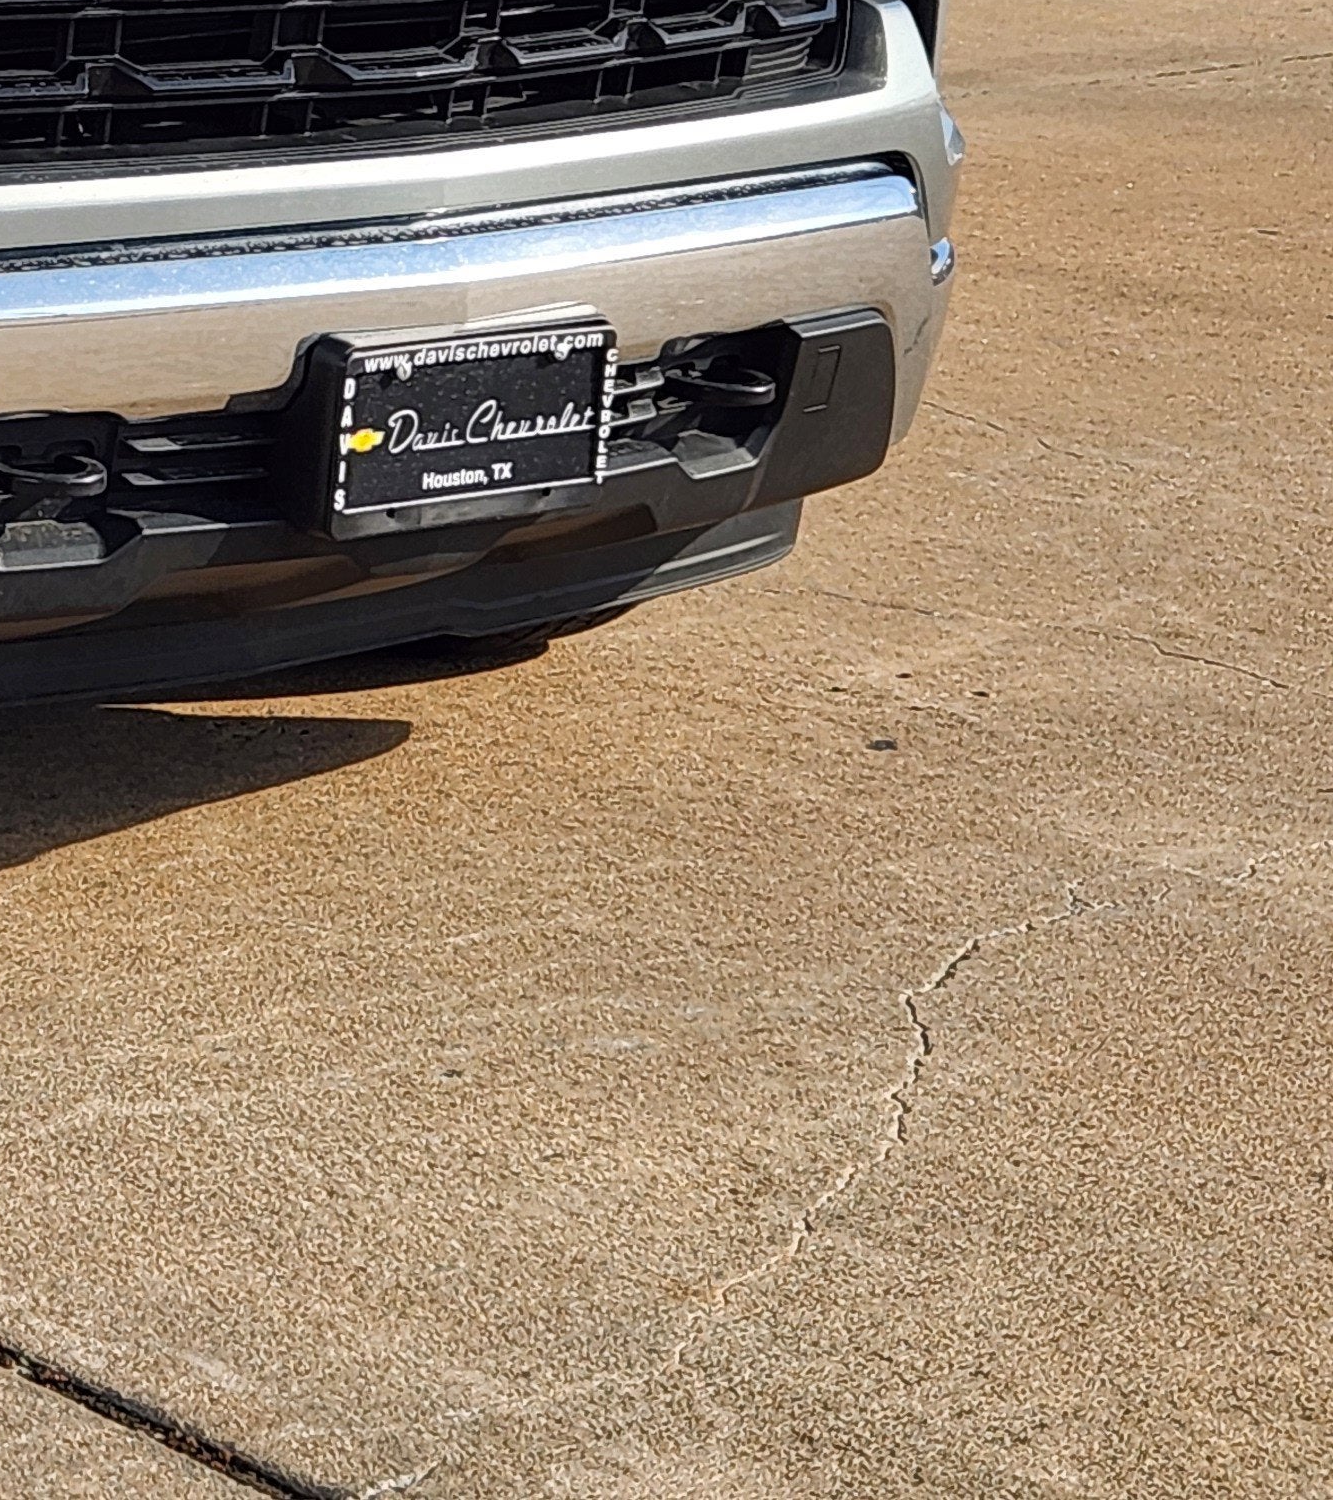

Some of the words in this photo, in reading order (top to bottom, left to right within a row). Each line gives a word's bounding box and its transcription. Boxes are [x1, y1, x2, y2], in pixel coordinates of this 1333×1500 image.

[364, 332, 604, 374] www.davischevrolet.com
[333, 377, 357, 512] DAVIS
[388, 409, 465, 454] Davis
[466, 399, 596, 444] Chevrolet
[594, 348, 620, 486] CHEVROLET
[421, 467, 489, 491] Houston,
[491, 461, 514, 481] TX
